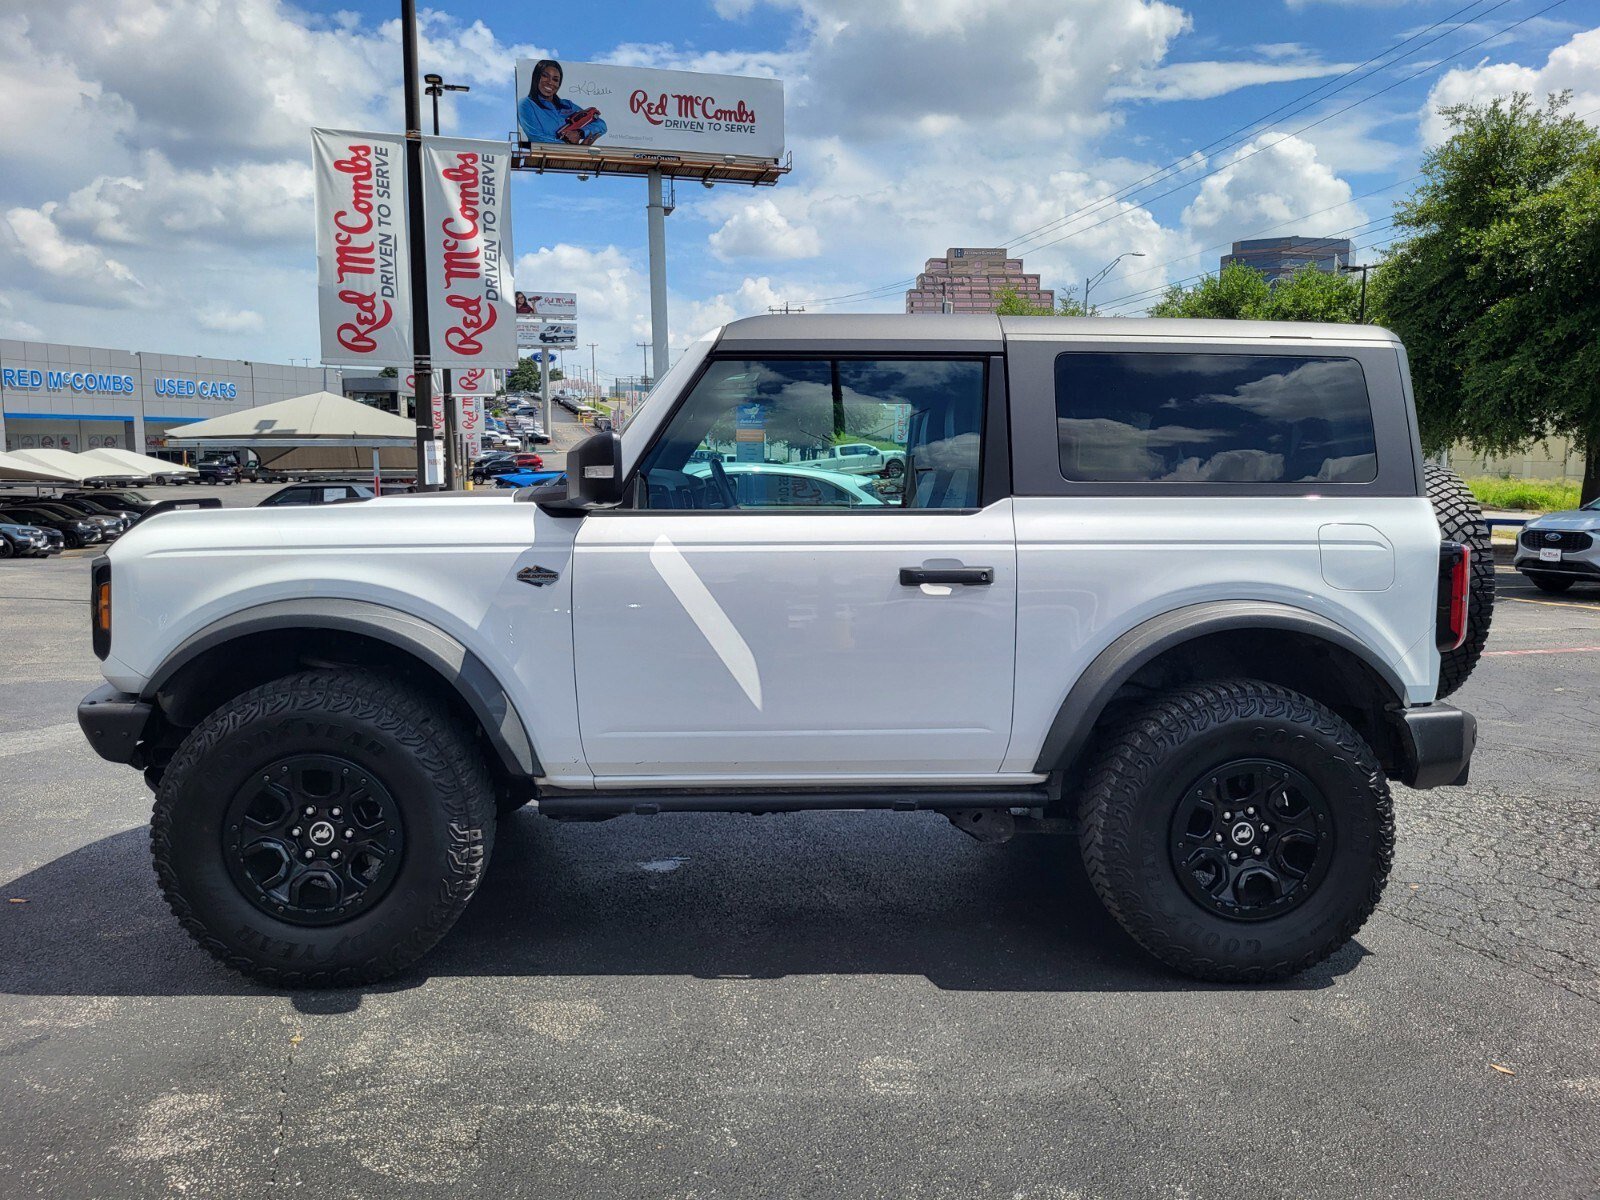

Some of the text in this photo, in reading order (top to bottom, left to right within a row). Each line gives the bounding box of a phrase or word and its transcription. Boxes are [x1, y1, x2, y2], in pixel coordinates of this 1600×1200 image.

[629, 89, 756, 125] Red McCombs
[665, 119, 756, 134] DRIVEN TO SERVE
[374, 145, 395, 299] DRIVEN TO SERVE
[481, 153, 499, 301] DRIVEN TO SERVE
[333, 145, 393, 353] Red McCombs
[442, 152, 497, 355] Red McCombs
[3, 368, 43, 387] RED
[155, 378, 237, 399] USED CARS
[459, 368, 485, 391] Re
